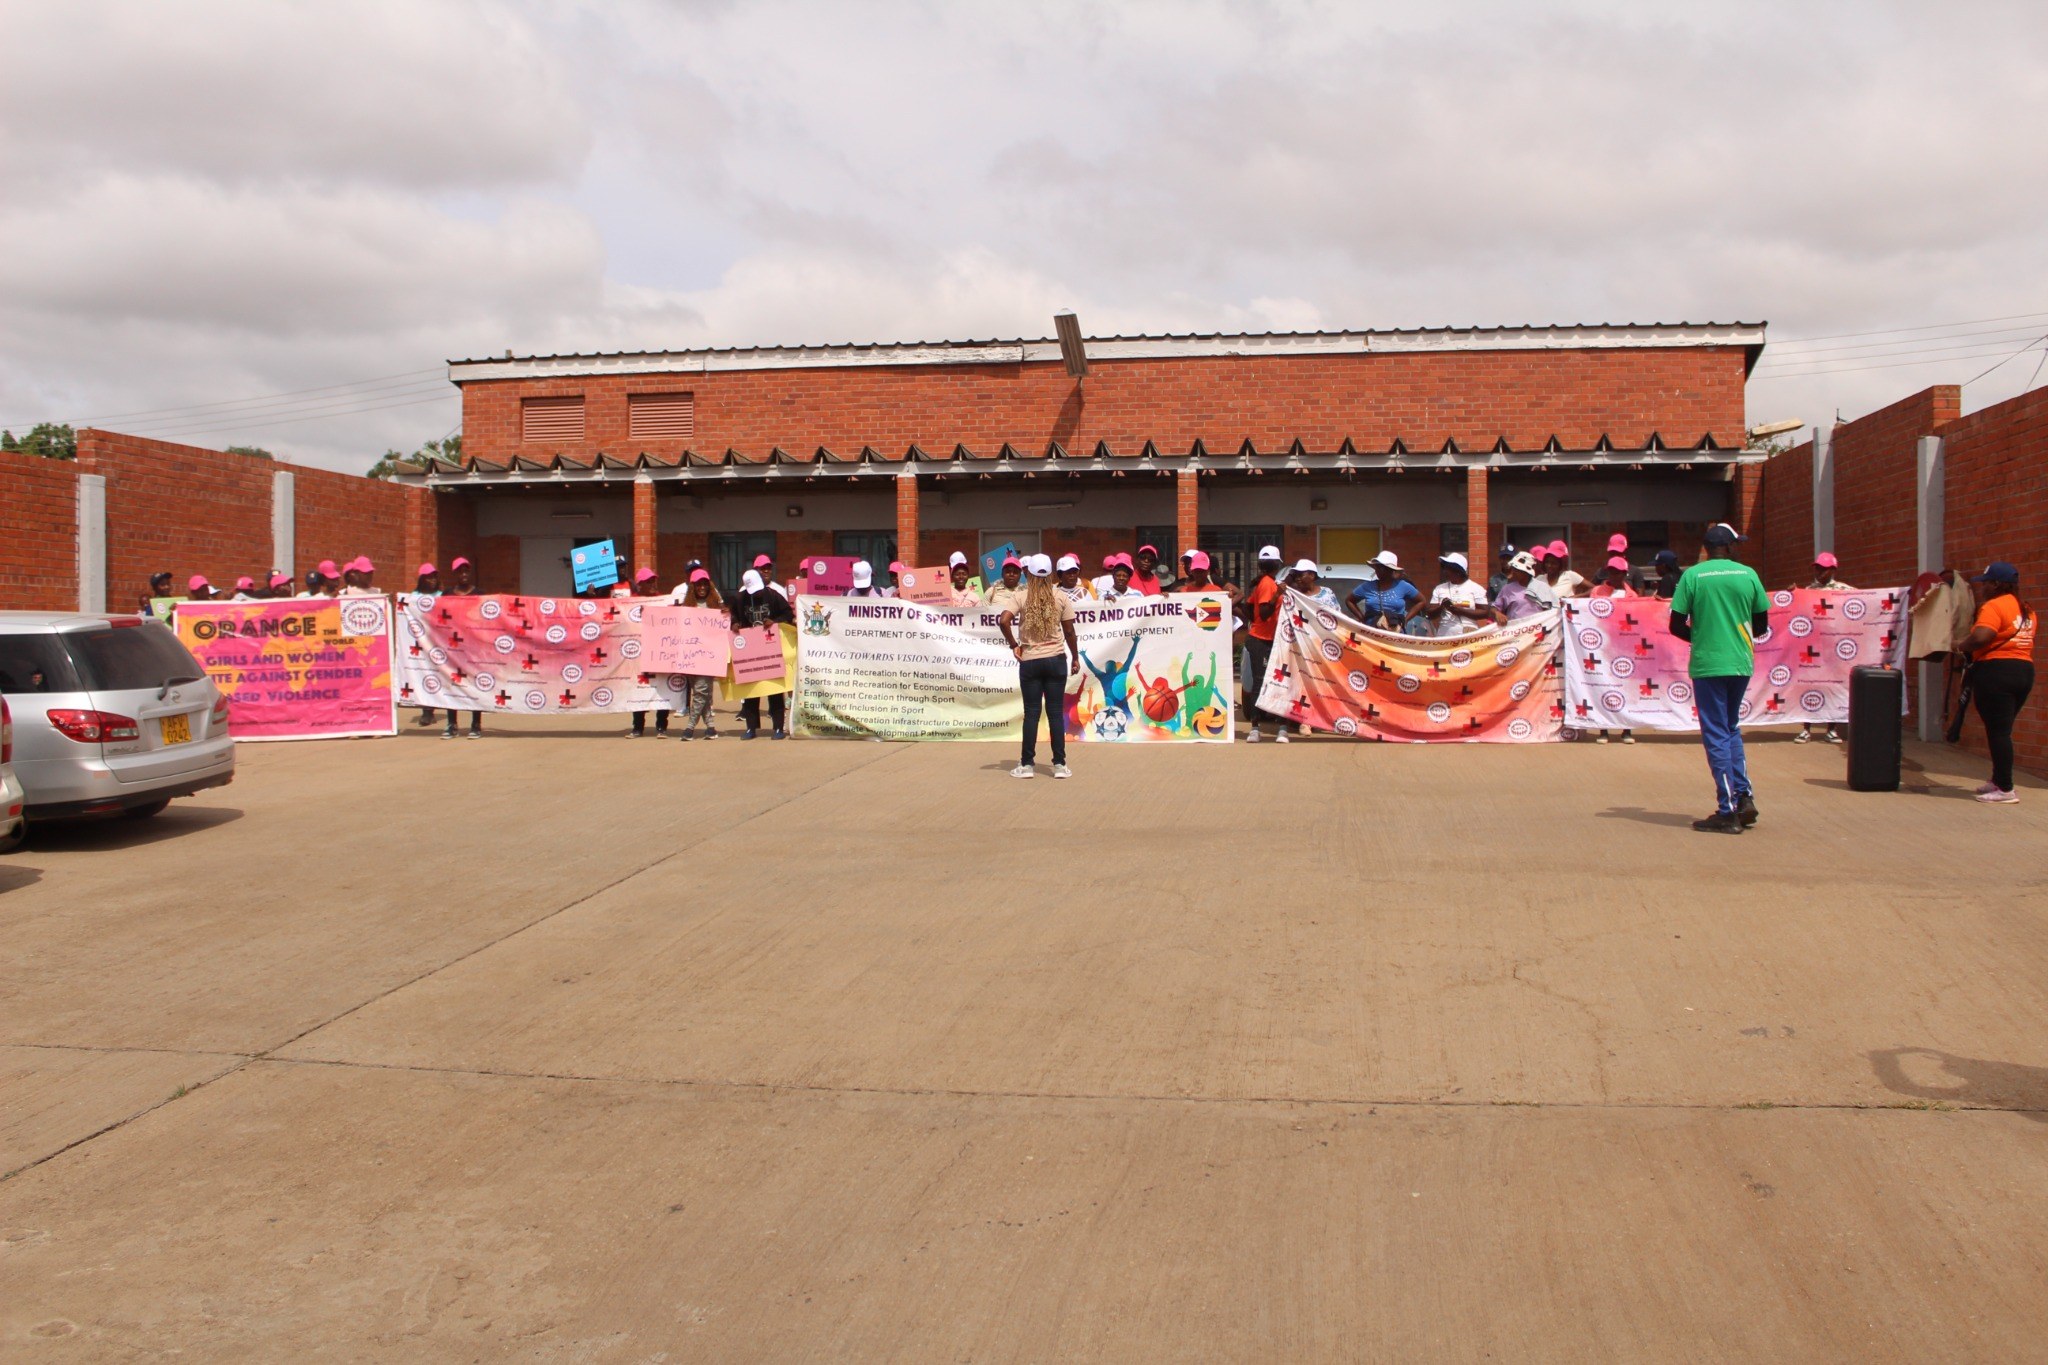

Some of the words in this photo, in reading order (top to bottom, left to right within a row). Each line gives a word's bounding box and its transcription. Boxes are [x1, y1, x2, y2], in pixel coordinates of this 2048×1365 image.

[848, 605, 904, 619] MINISTRY
[907, 608, 921, 620] OF
[926, 613, 964, 627] SPORT
[1100, 609, 1123, 622] AND
[1128, 603, 1182, 619] CULTURE
[193, 617, 316, 640] ORANGE
[845, 629, 903, 639] DEPARTMENT
[920, 633, 955, 643] SPORTS
[958, 637, 977, 645] AND
[1107, 627, 1174, 638] DEVELOPMENT
[206, 654, 247, 666] GIRLS
[252, 654, 283, 665] AND
[287, 651, 345, 663] WOMEN
[806, 650, 847, 658] MOVING
[849, 652, 894, 661] TOWARDS
[897, 654, 928, 663] VISION
[931, 656, 951, 664] 2030
[237, 670, 300, 683] AGAINST
[304, 668, 363, 679] GENDER
[804, 665, 832, 674] Sports
[853, 668, 897, 677] Recreation
[914, 671, 947, 679] National
[949, 673, 985, 683] Building
[804, 678, 831, 686] Sports
[852, 680, 897, 689] Recreation
[914, 683, 955, 692] Economic
[957, 685, 1013, 694] Development
[267, 689, 340, 702] VIOLENCE
[804, 690, 855, 699] Employment
[858, 692, 894, 700] Creation
[897, 694, 929, 703] through
[932, 696, 955, 704] Sport
[804, 701, 829, 710] Equity
[849, 704, 888, 713] Inclusion
[901, 706, 924, 715] Sport
[805, 713, 826, 721] Sport
[845, 715, 892, 724] Recreation
[893, 717, 950, 726] Infrastructure
[953, 720, 1009, 729] Development
[835, 725, 864, 733] Athlete
[921, 730, 962, 738] Pathways
